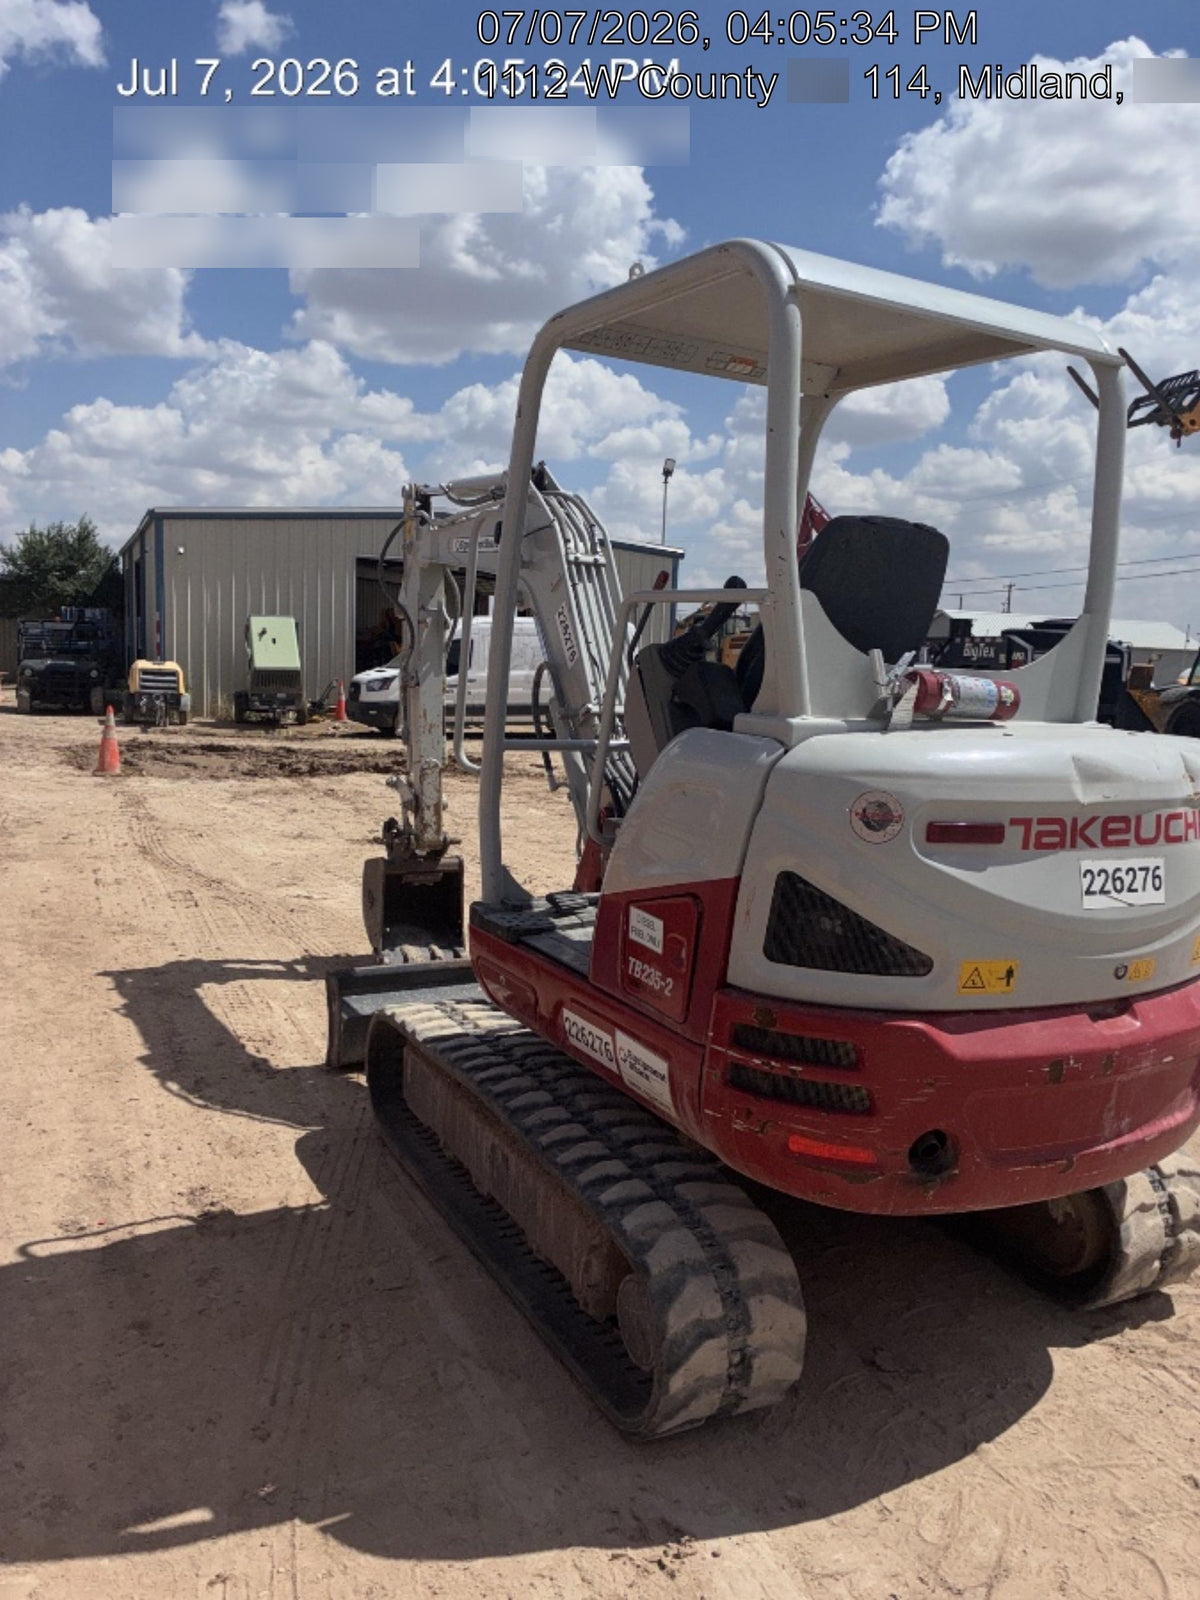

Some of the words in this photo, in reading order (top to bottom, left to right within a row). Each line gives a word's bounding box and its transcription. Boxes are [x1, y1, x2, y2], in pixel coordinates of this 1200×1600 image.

[1082, 865, 1163, 896] 226276
[628, 956, 674, 997] TB235-2
[565, 1016, 614, 1063] 226276
